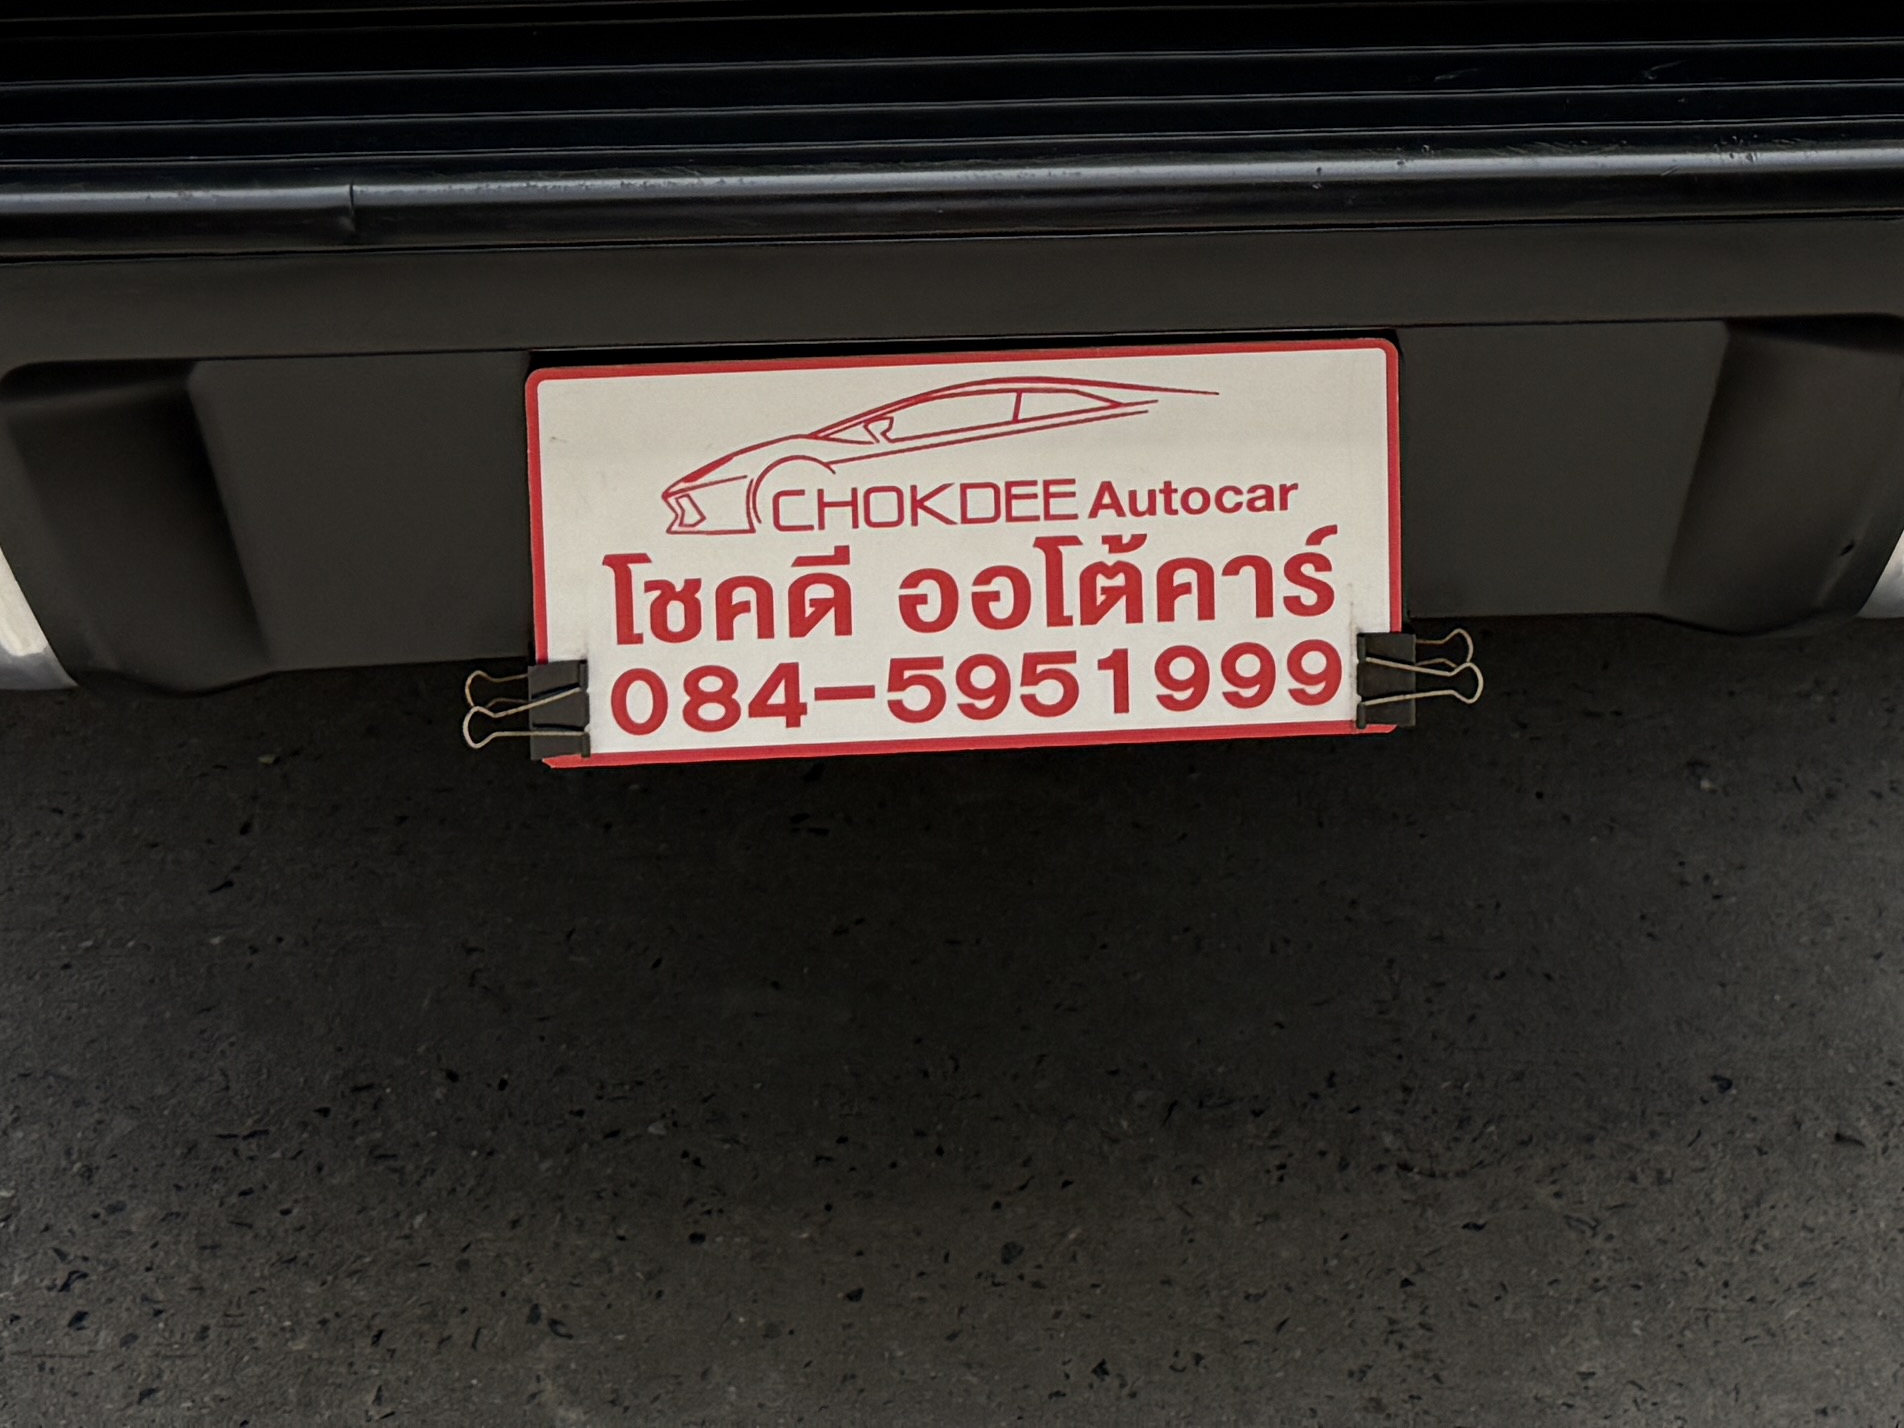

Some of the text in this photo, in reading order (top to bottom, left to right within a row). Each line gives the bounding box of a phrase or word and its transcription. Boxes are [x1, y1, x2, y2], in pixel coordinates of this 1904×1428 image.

[771, 478, 1300, 534] CHOKDEE Autocar
[602, 524, 1339, 646] โชคดี ออโต้คาร์
[610, 639, 1344, 736] 084-5951999
